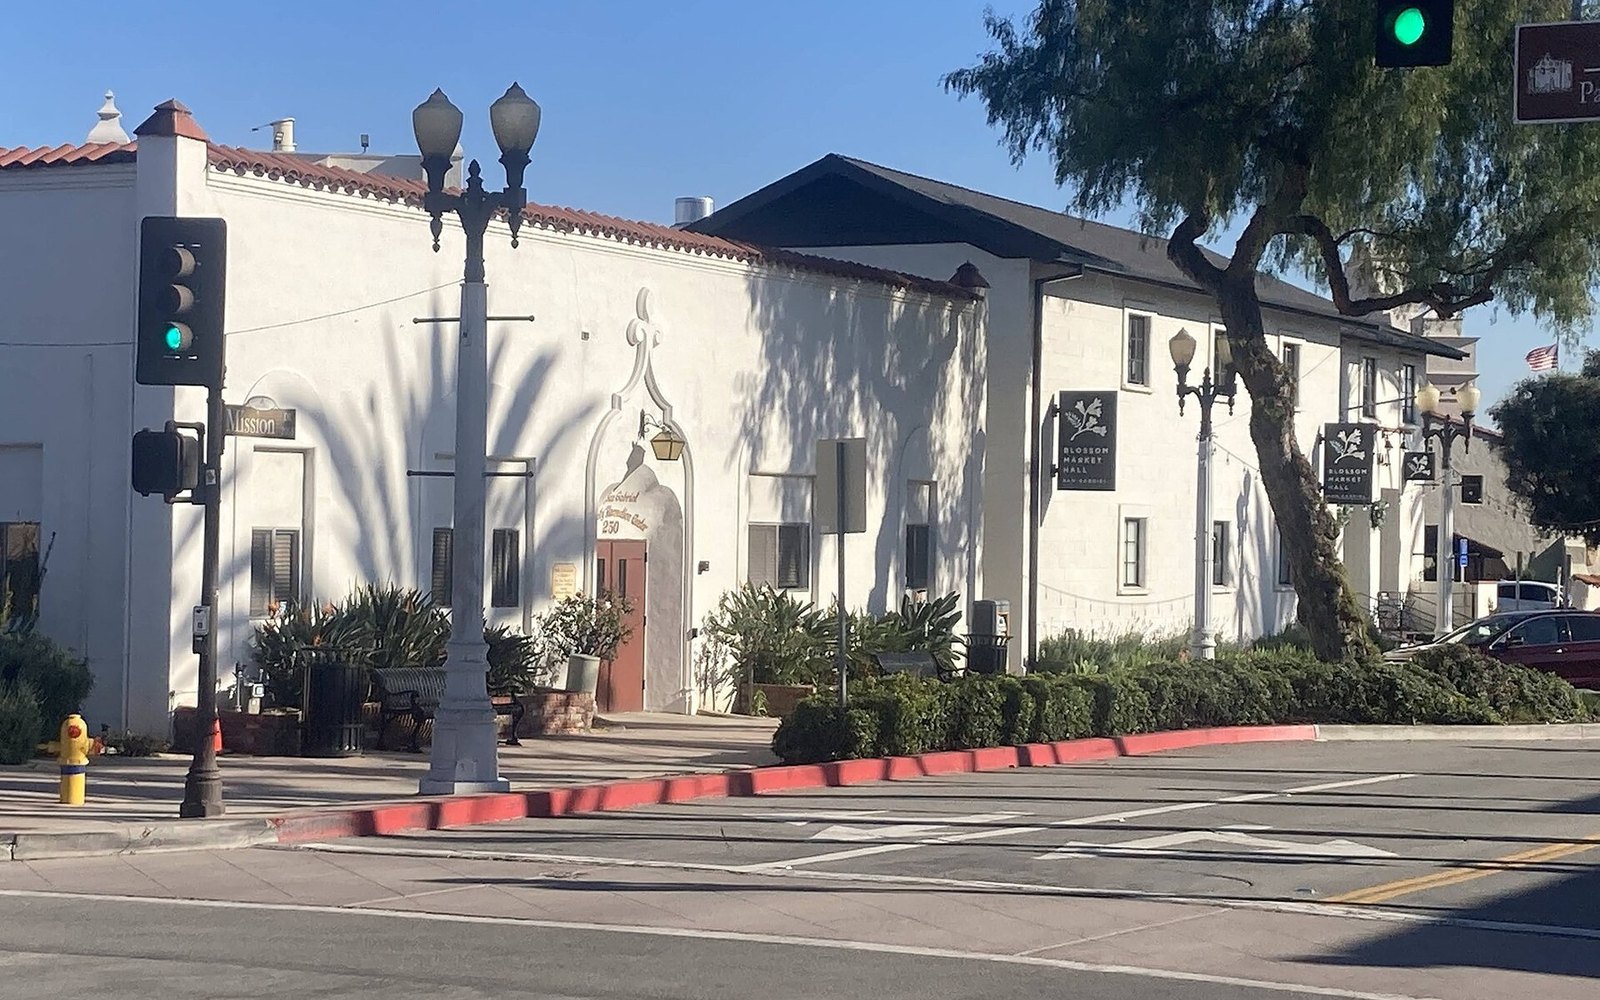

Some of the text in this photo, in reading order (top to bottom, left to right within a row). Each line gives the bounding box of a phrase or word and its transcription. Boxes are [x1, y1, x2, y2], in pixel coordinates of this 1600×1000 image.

[225, 408, 276, 435] Mission
[1063, 456, 1102, 464] MARKET
[1063, 466, 1087, 474] HALL
[602, 520, 620, 534] 250
